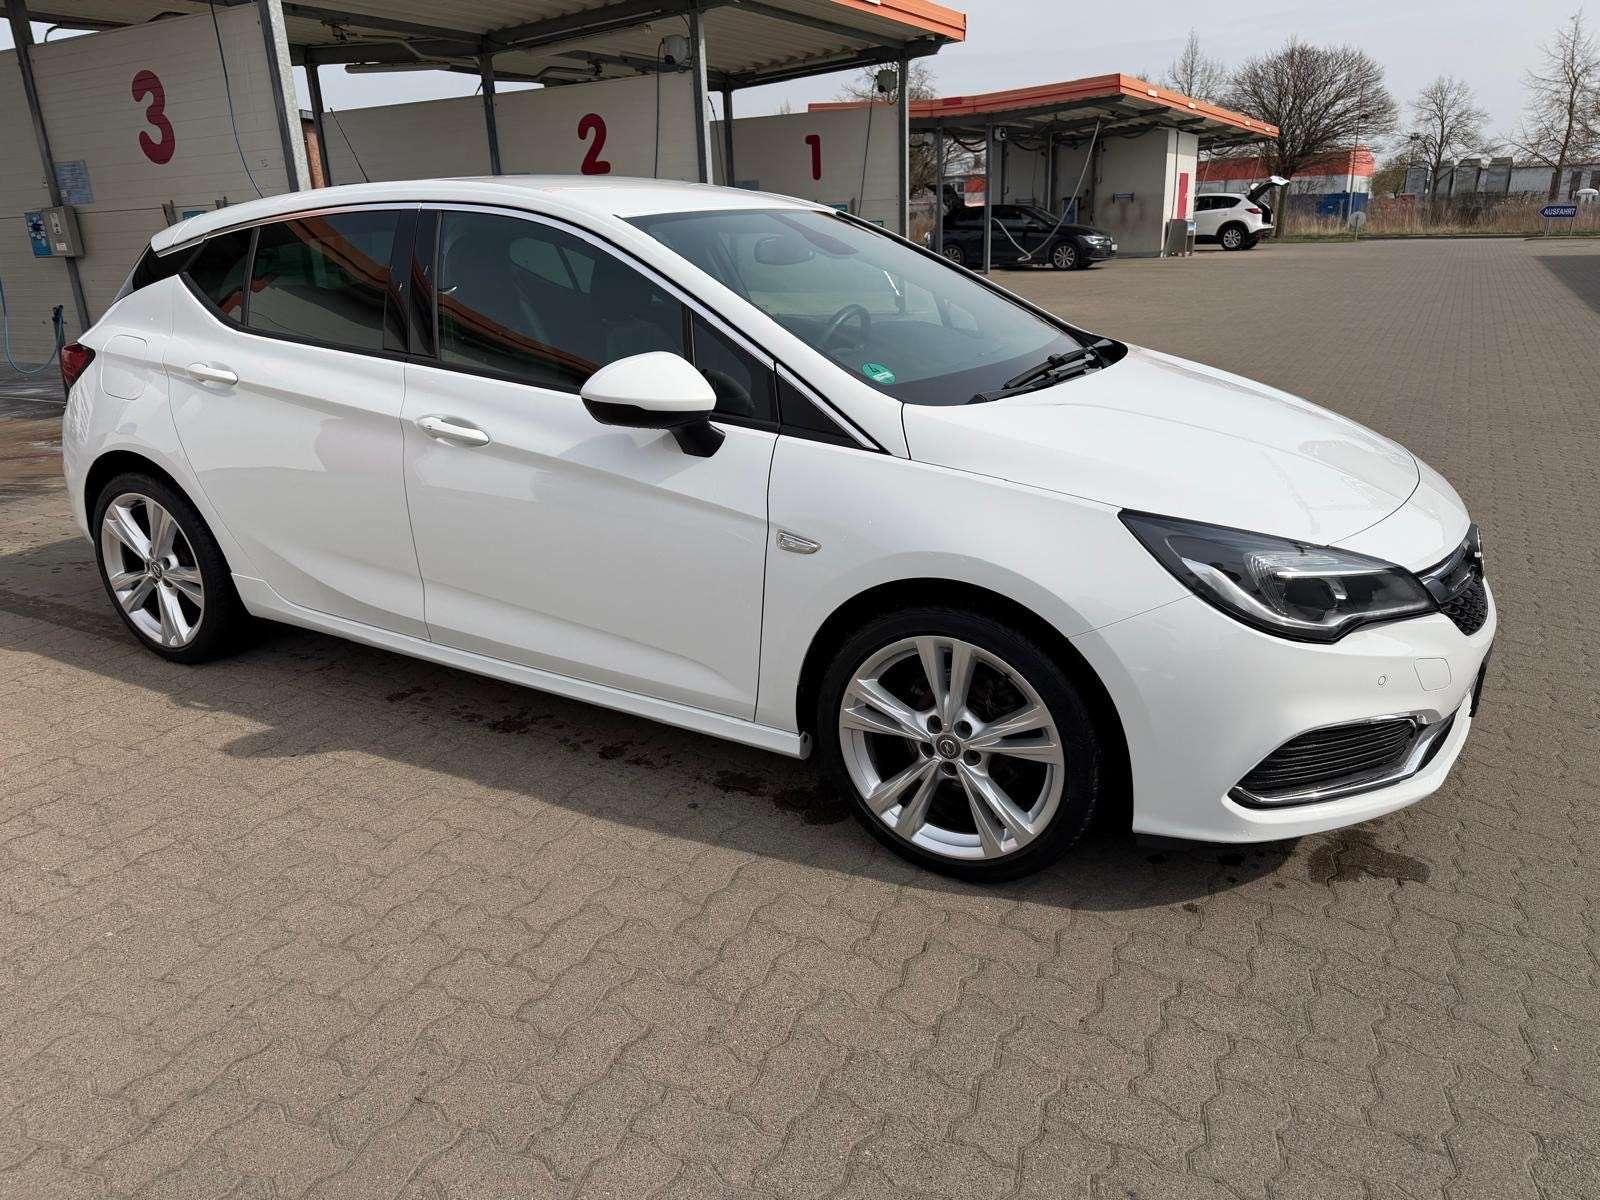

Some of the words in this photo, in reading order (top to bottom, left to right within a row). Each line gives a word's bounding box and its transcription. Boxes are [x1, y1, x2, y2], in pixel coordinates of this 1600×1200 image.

[132, 70, 175, 165] 3
[577, 113, 611, 176] 2
[805, 134, 821, 180] 1
[1544, 208, 1575, 216] AUSFAHRT
